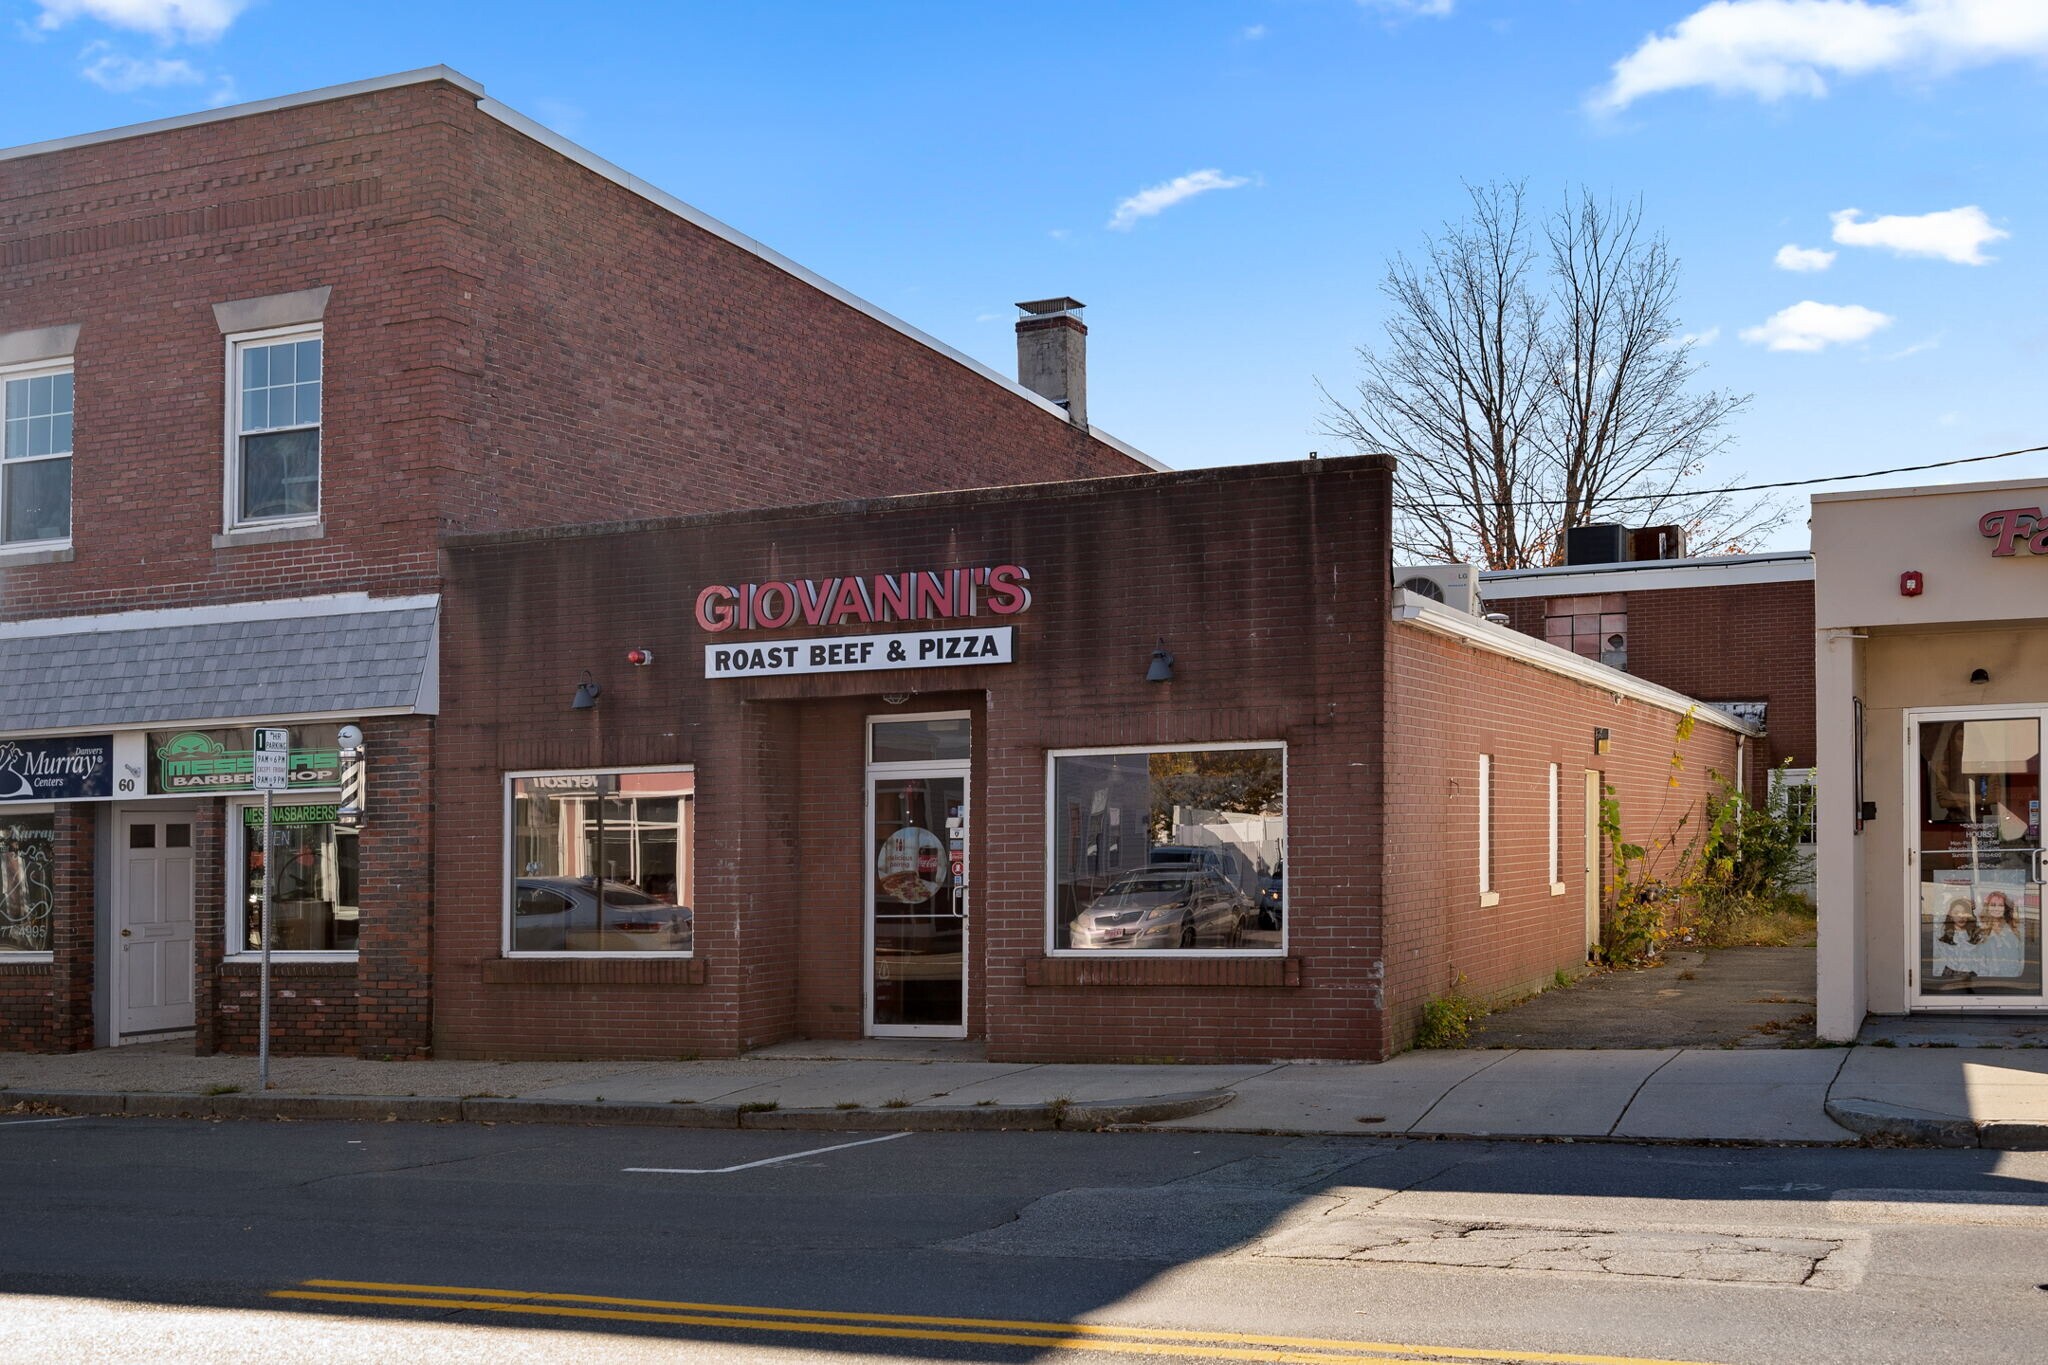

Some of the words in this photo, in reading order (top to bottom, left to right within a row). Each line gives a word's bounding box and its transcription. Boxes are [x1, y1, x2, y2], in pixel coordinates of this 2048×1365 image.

[695, 565, 1032, 632] GIOVANNI'S
[715, 647, 798, 671] ROAST
[810, 642, 874, 666] BEEF
[887, 639, 906, 662] &
[919, 634, 999, 660] PIZZA
[258, 733, 263, 748] 1
[266, 741, 286, 750] PARKING
[75, 747, 103, 756] Danvers
[257, 755, 269, 763] 9AM
[274, 755, 285, 763] 6PM
[34, 777, 64, 788] Centers
[118, 778, 135, 792] 60
[257, 776, 269, 784] 9AM
